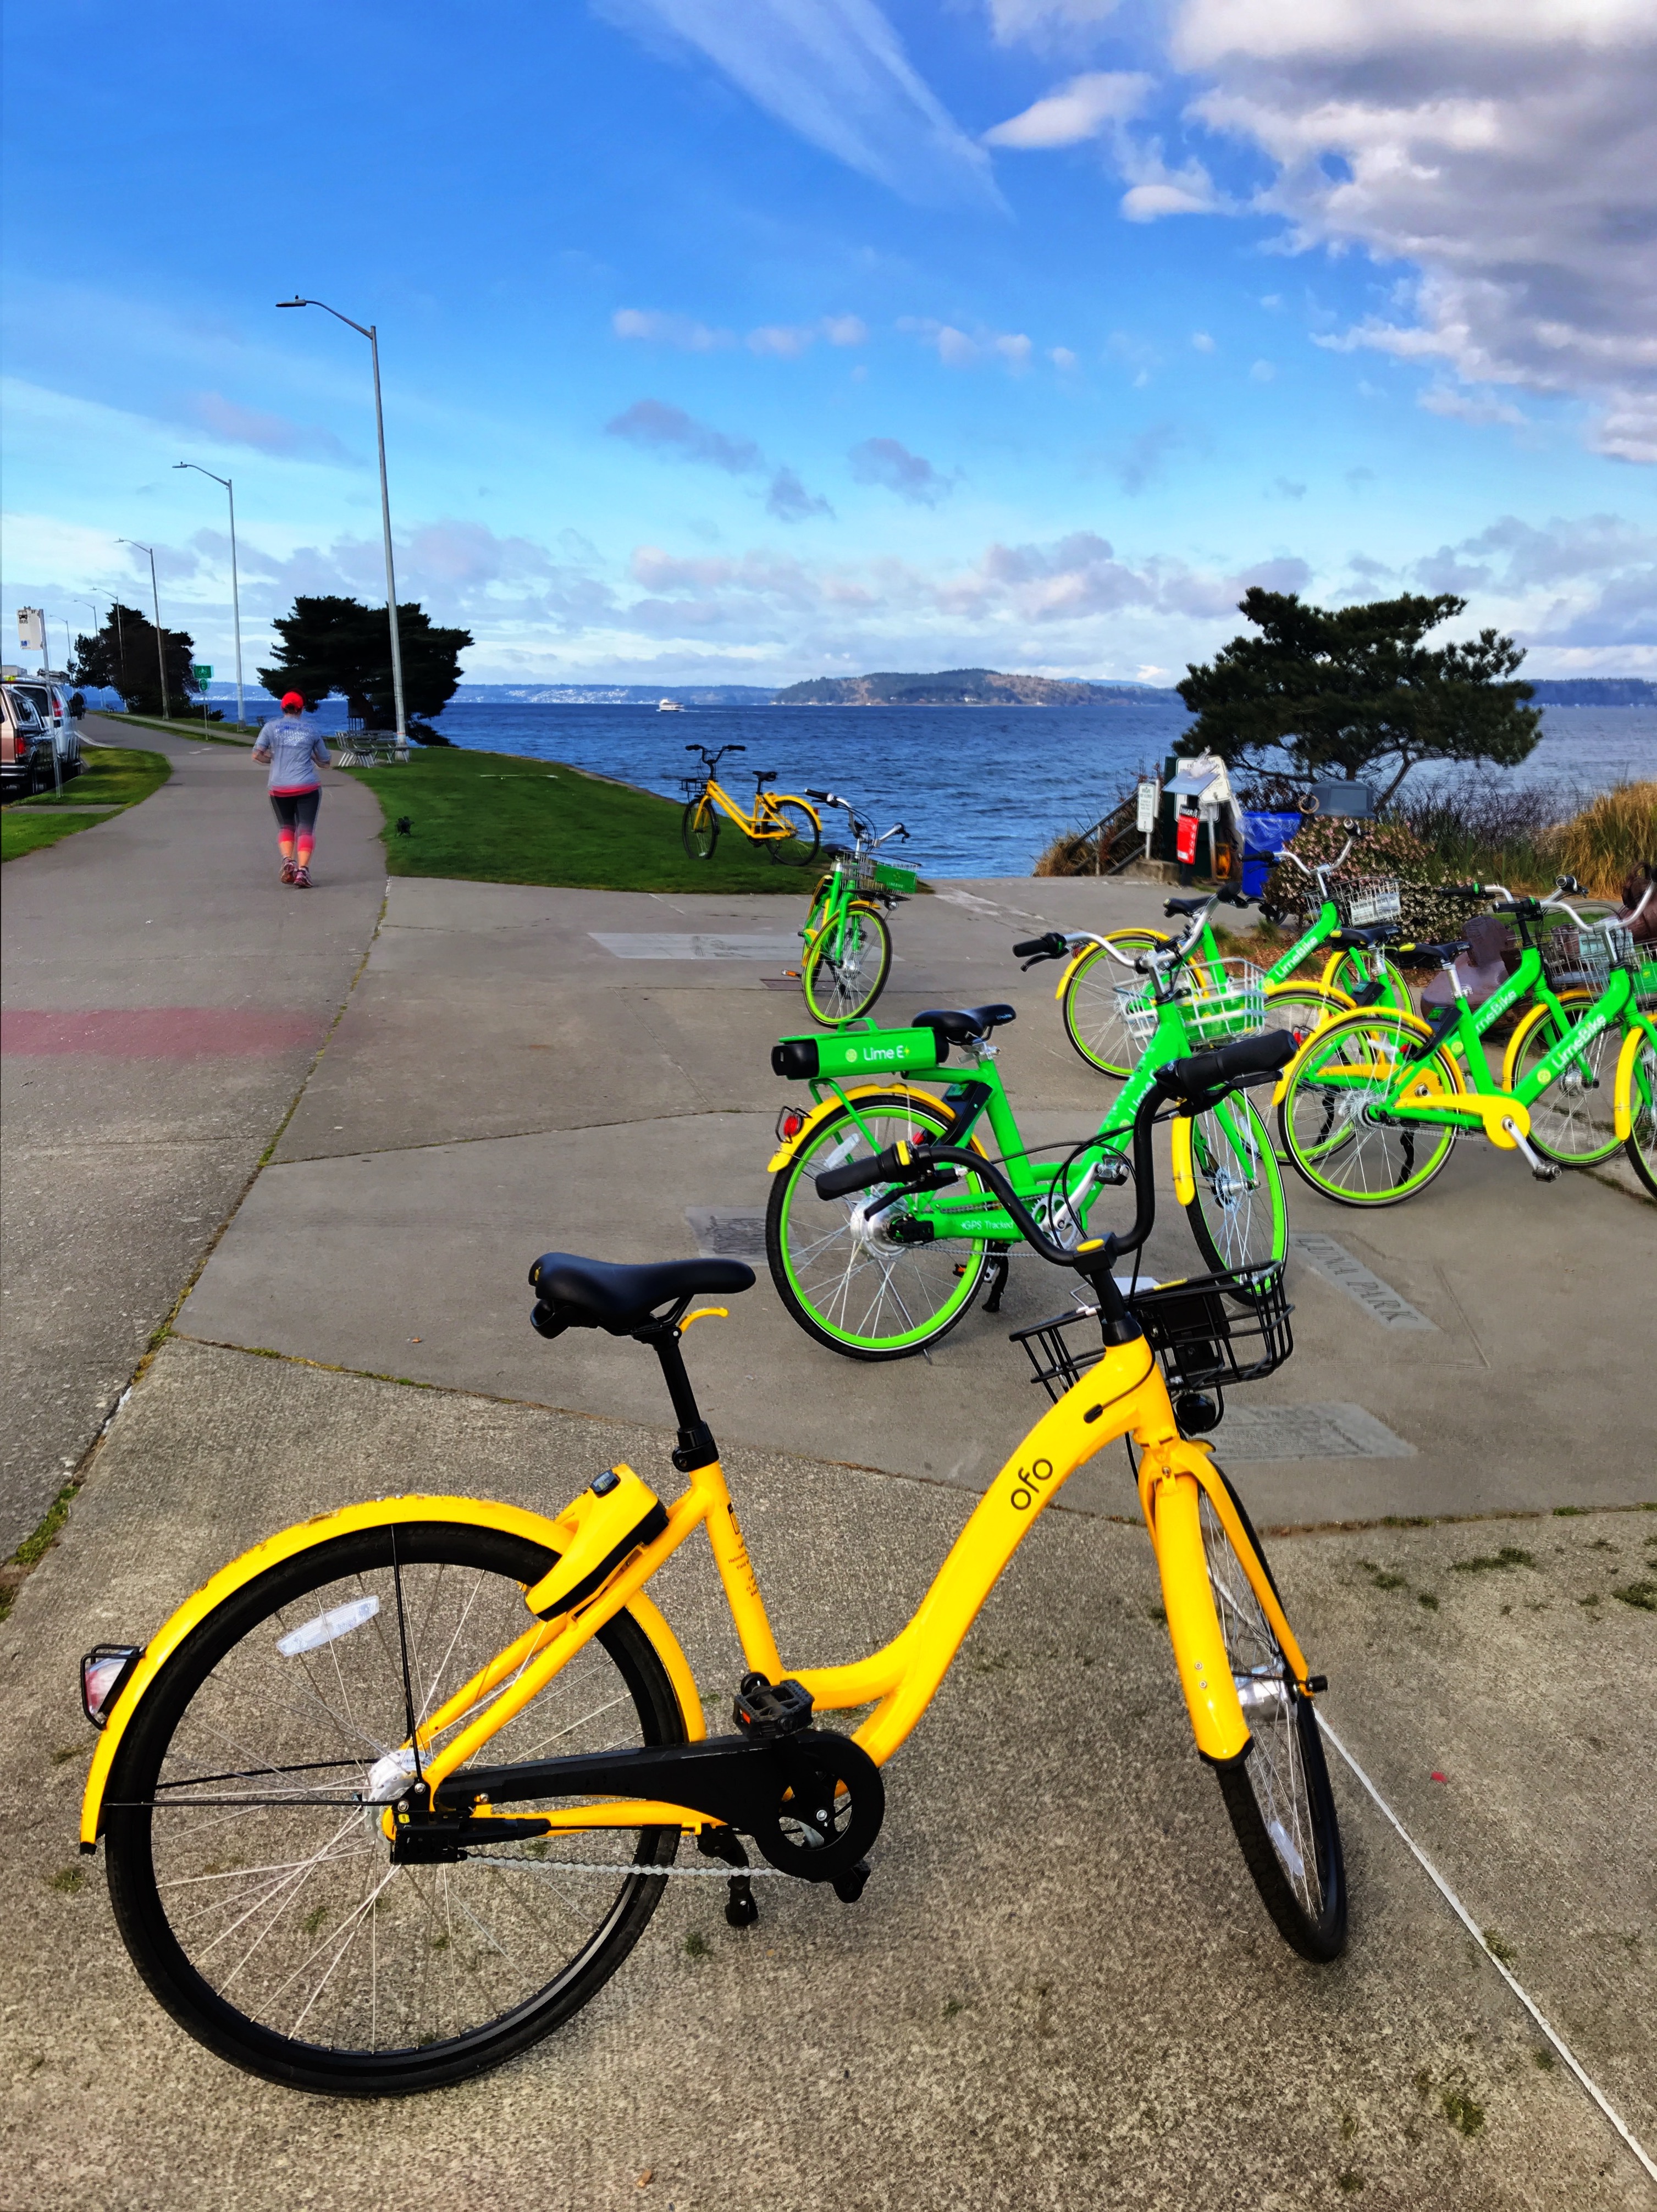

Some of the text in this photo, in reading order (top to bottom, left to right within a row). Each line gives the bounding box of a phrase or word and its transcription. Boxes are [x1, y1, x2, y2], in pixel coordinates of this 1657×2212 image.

[1275, 936, 1318, 978] LimeBike
[1475, 990, 1517, 1034] meBike
[863, 1046, 895, 1061] Lime
[1551, 1014, 1607, 1070] LimeBike
[965, 1220, 1014, 1230] GPS Tracked
[1295, 1238, 1419, 1323] LUNA PARK
[1010, 1457, 1053, 1511] ofo
